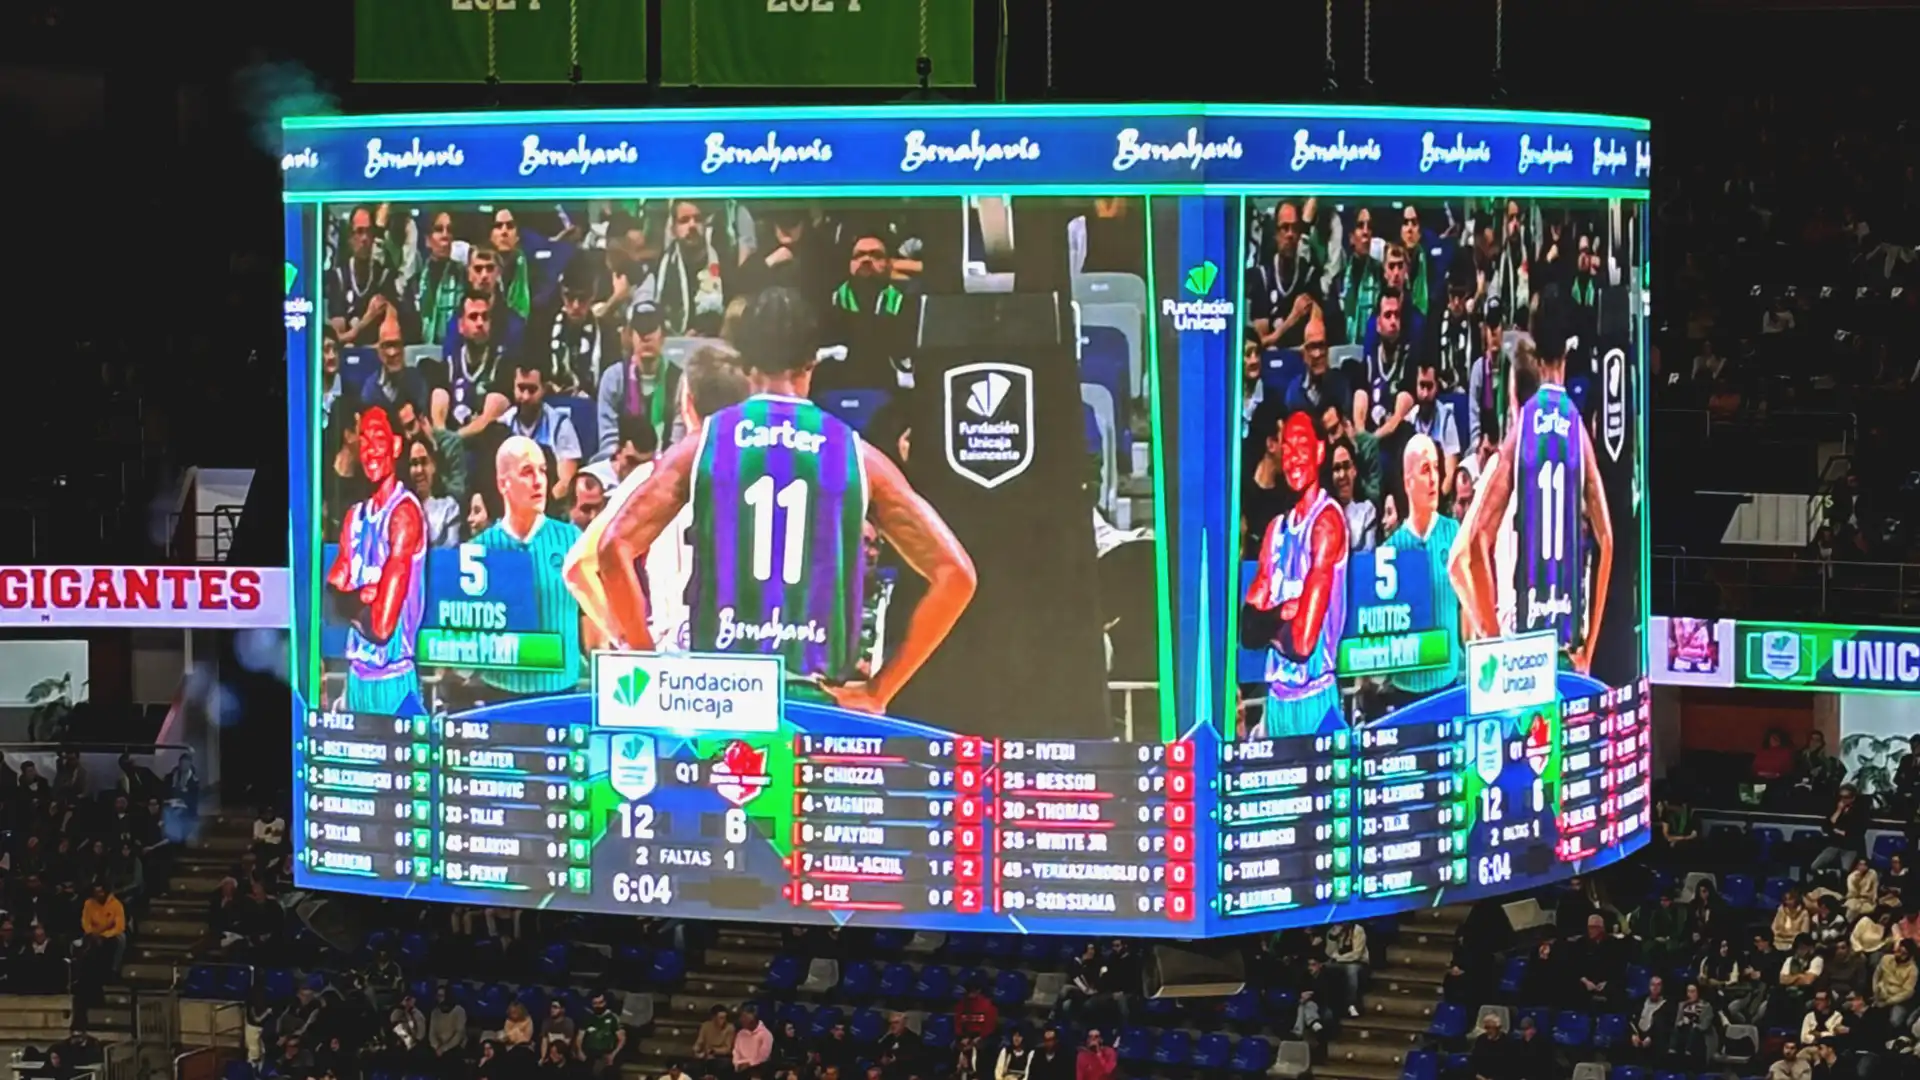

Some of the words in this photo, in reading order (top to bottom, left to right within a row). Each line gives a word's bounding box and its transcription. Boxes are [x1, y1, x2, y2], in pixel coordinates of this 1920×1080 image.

[734, 418, 827, 454] Carter
[1537, 459, 1566, 562] 11
[743, 474, 808, 585] 11
[459, 542, 488, 596] 5
[1374, 545, 1398, 600] 5
[0, 567, 262, 611] GIGANTES
[438, 600, 507, 629] PUNTOS
[1832, 638, 1920, 683] UNIC
[658, 692, 734, 719] Unicaja
[803, 735, 812, 753] 1
[823, 736, 883, 754] PICKETT
[928, 741, 940, 757] 0
[943, 741, 954, 756] F
[962, 741, 974, 757] 2
[1138, 745, 1150, 762] 0
[1153, 746, 1164, 761] F
[1173, 745, 1185, 762] 0
[675, 762, 699, 782] Q1
[928, 770, 940, 786] 0
[943, 771, 954, 786] F
[962, 770, 974, 787] 0
[1138, 775, 1150, 792] 0
[1153, 776, 1165, 792] F
[1173, 775, 1185, 792] 0
[929, 800, 941, 817] 0
[942, 800, 954, 816] F
[962, 800, 974, 817] 0
[1035, 802, 1100, 821] THOMAS
[1138, 805, 1150, 823] 0
[1153, 806, 1165, 822] F
[1173, 806, 1185, 822] 0
[1480, 786, 1502, 822] 12
[618, 804, 654, 840] 12
[725, 808, 747, 844] 6
[928, 830, 940, 846] 0
[942, 830, 954, 846] F
[962, 830, 974, 846] 0
[1137, 835, 1150, 853] 0
[1153, 836, 1165, 852] F
[1173, 836, 1185, 853] 0
[635, 846, 649, 865] 2
[659, 848, 712, 867] FALTAS
[724, 849, 735, 870] 1
[802, 853, 814, 872] 7
[928, 859, 938, 876] 1
[942, 860, 954, 876] F
[962, 860, 974, 876] 2
[1478, 852, 1512, 886] 6:04
[1153, 866, 1164, 882] F
[1173, 866, 1185, 883] 0
[612, 873, 672, 904] 6:04
[928, 889, 940, 906] 0
[962, 889, 974, 907] 2
[1137, 895, 1150, 913] 0
[1153, 896, 1165, 912] F
[1173, 896, 1185, 913] 0
